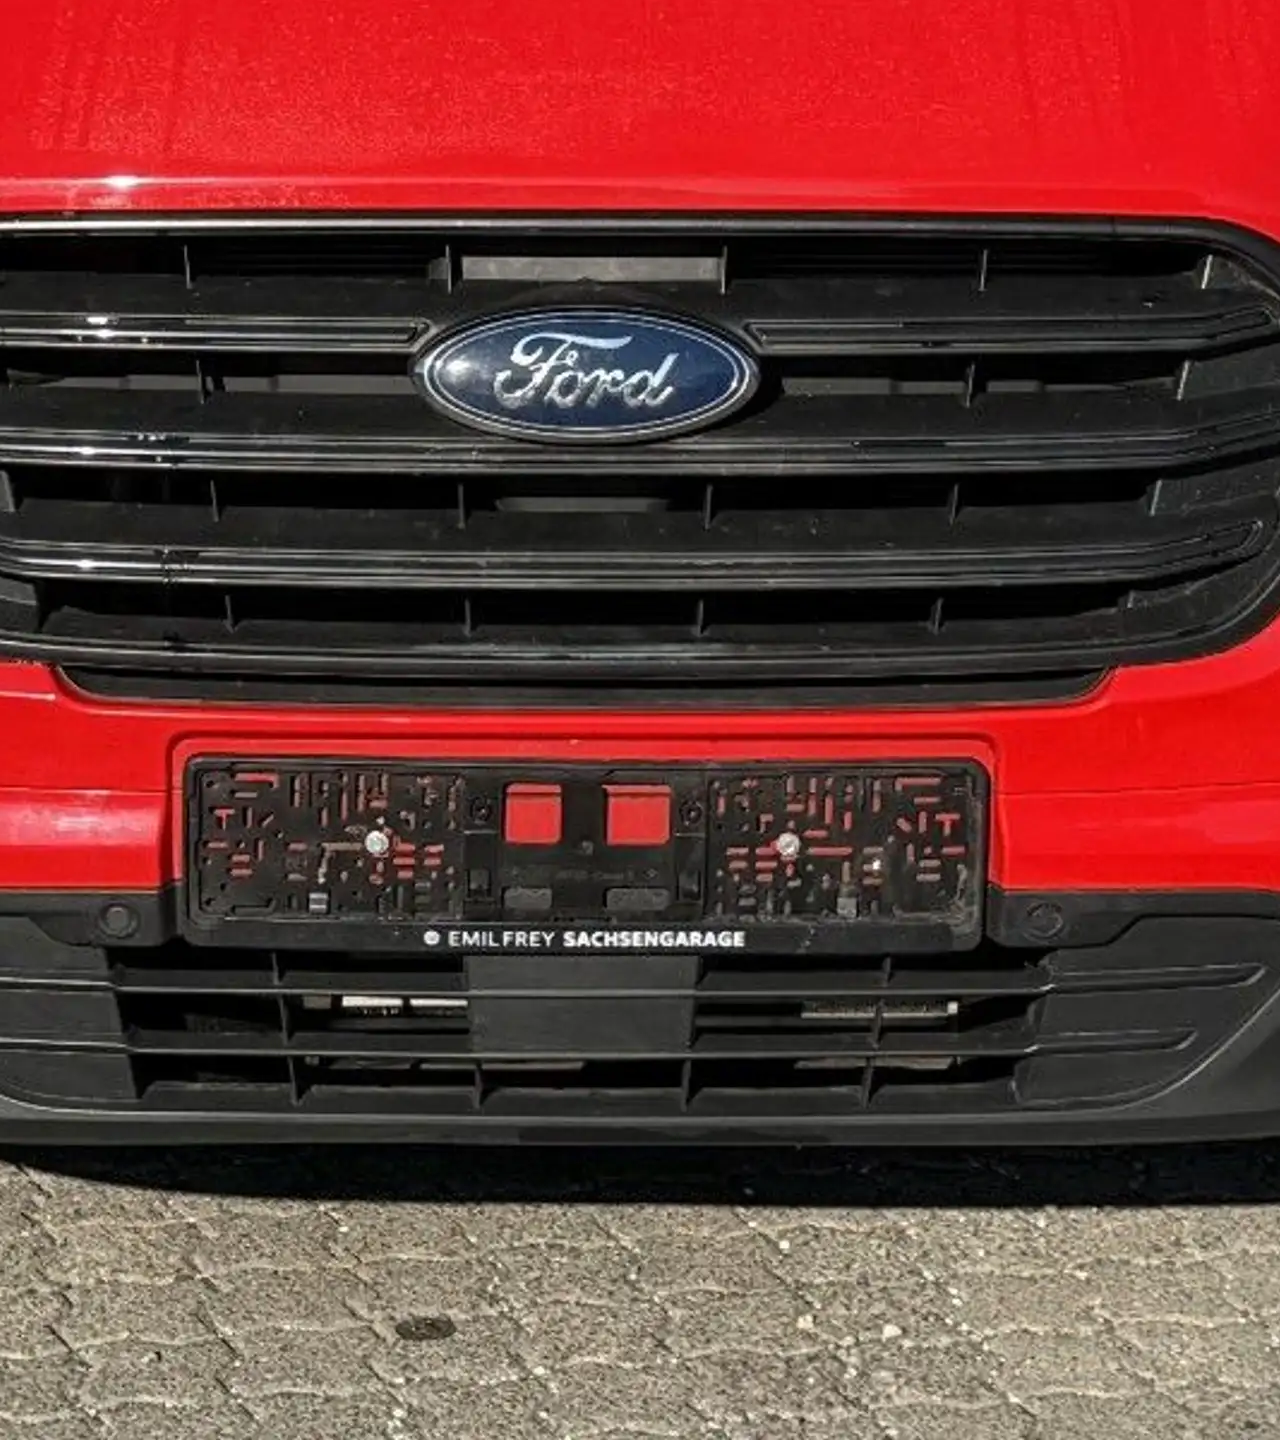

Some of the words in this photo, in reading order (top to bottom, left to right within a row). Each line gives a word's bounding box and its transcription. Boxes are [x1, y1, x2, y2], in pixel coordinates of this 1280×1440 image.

[494, 331, 680, 409] Ford
[447, 931, 502, 948] EMIL
[503, 931, 556, 948] FREY
[562, 931, 746, 948] SACHSENGARAGE
